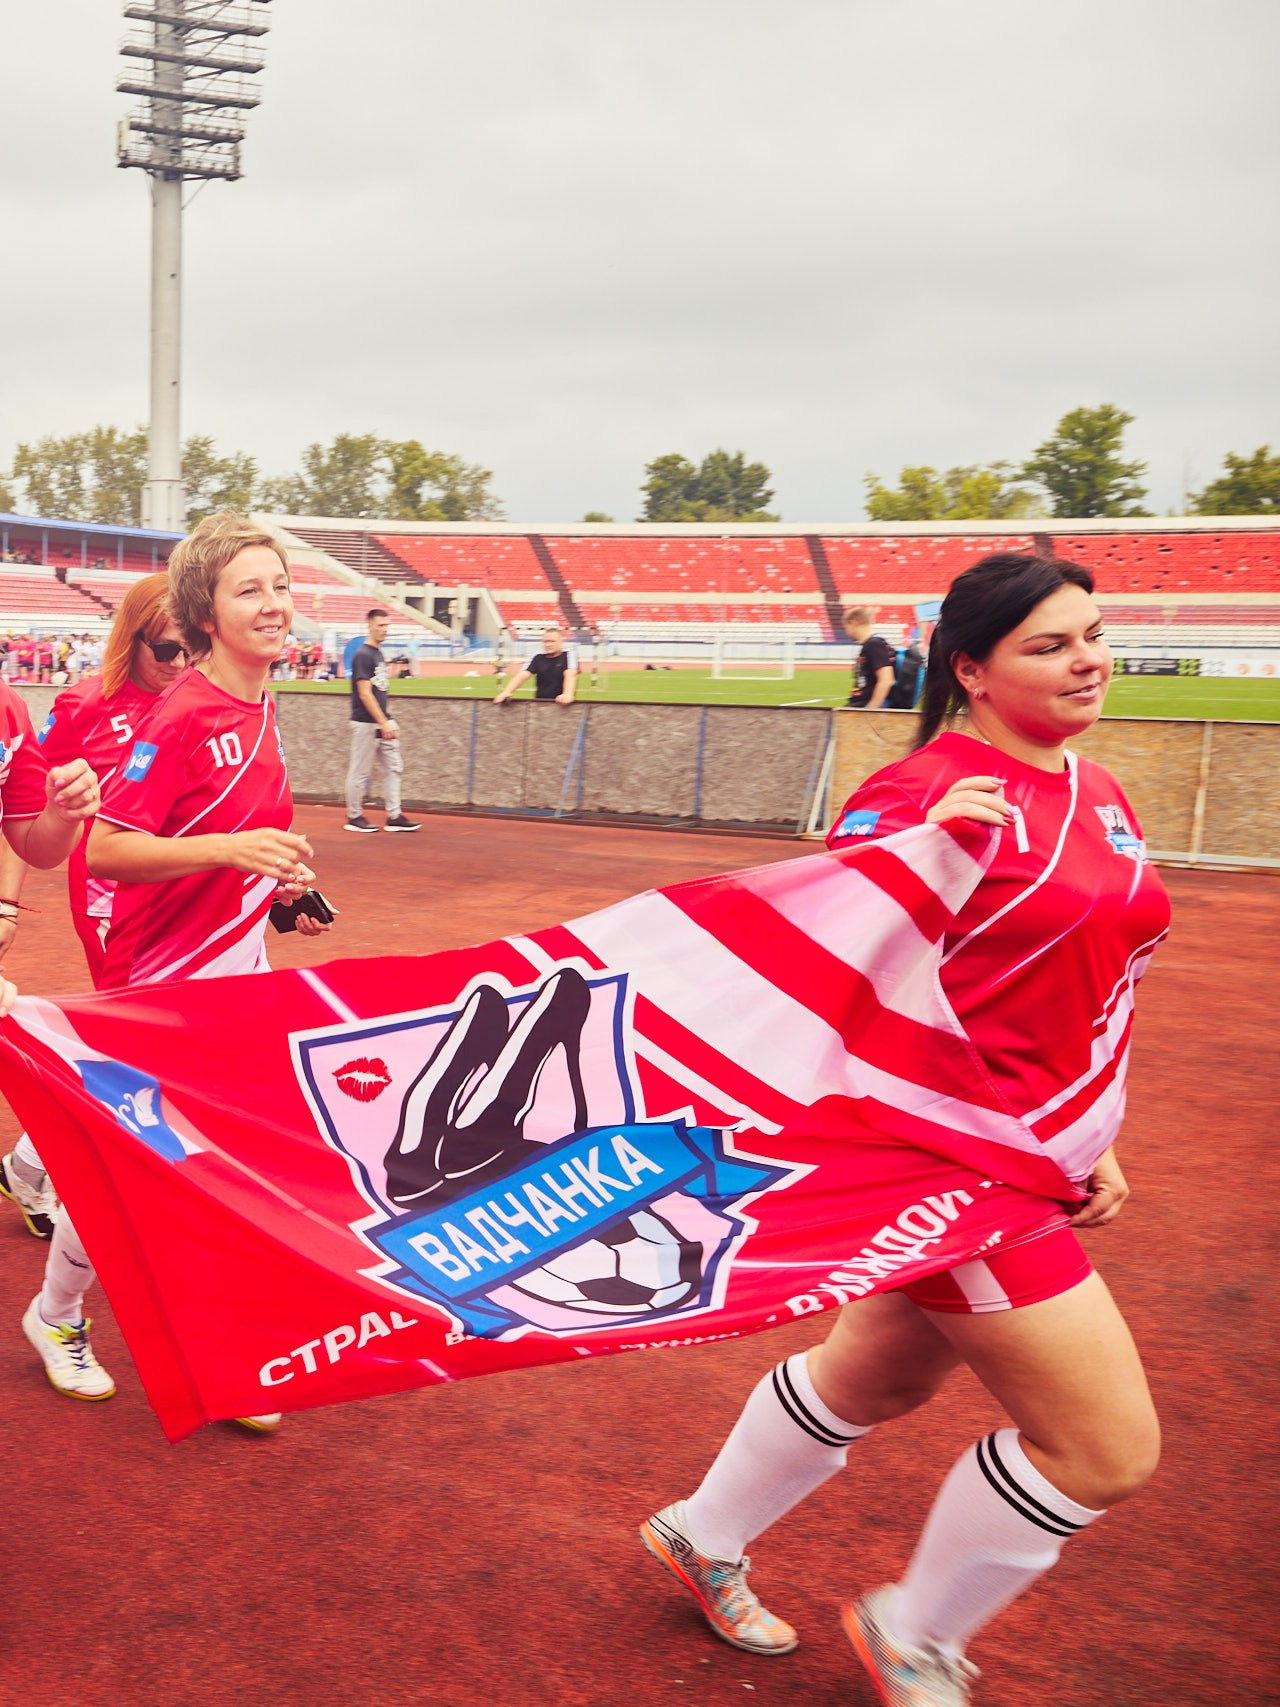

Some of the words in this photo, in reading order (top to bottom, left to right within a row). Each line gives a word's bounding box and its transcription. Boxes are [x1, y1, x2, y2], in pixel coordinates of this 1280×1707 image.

[110, 714, 133, 744] 5
[205, 731, 243, 768] 10
[407, 1134, 665, 1282] ВАДЧАНКА
